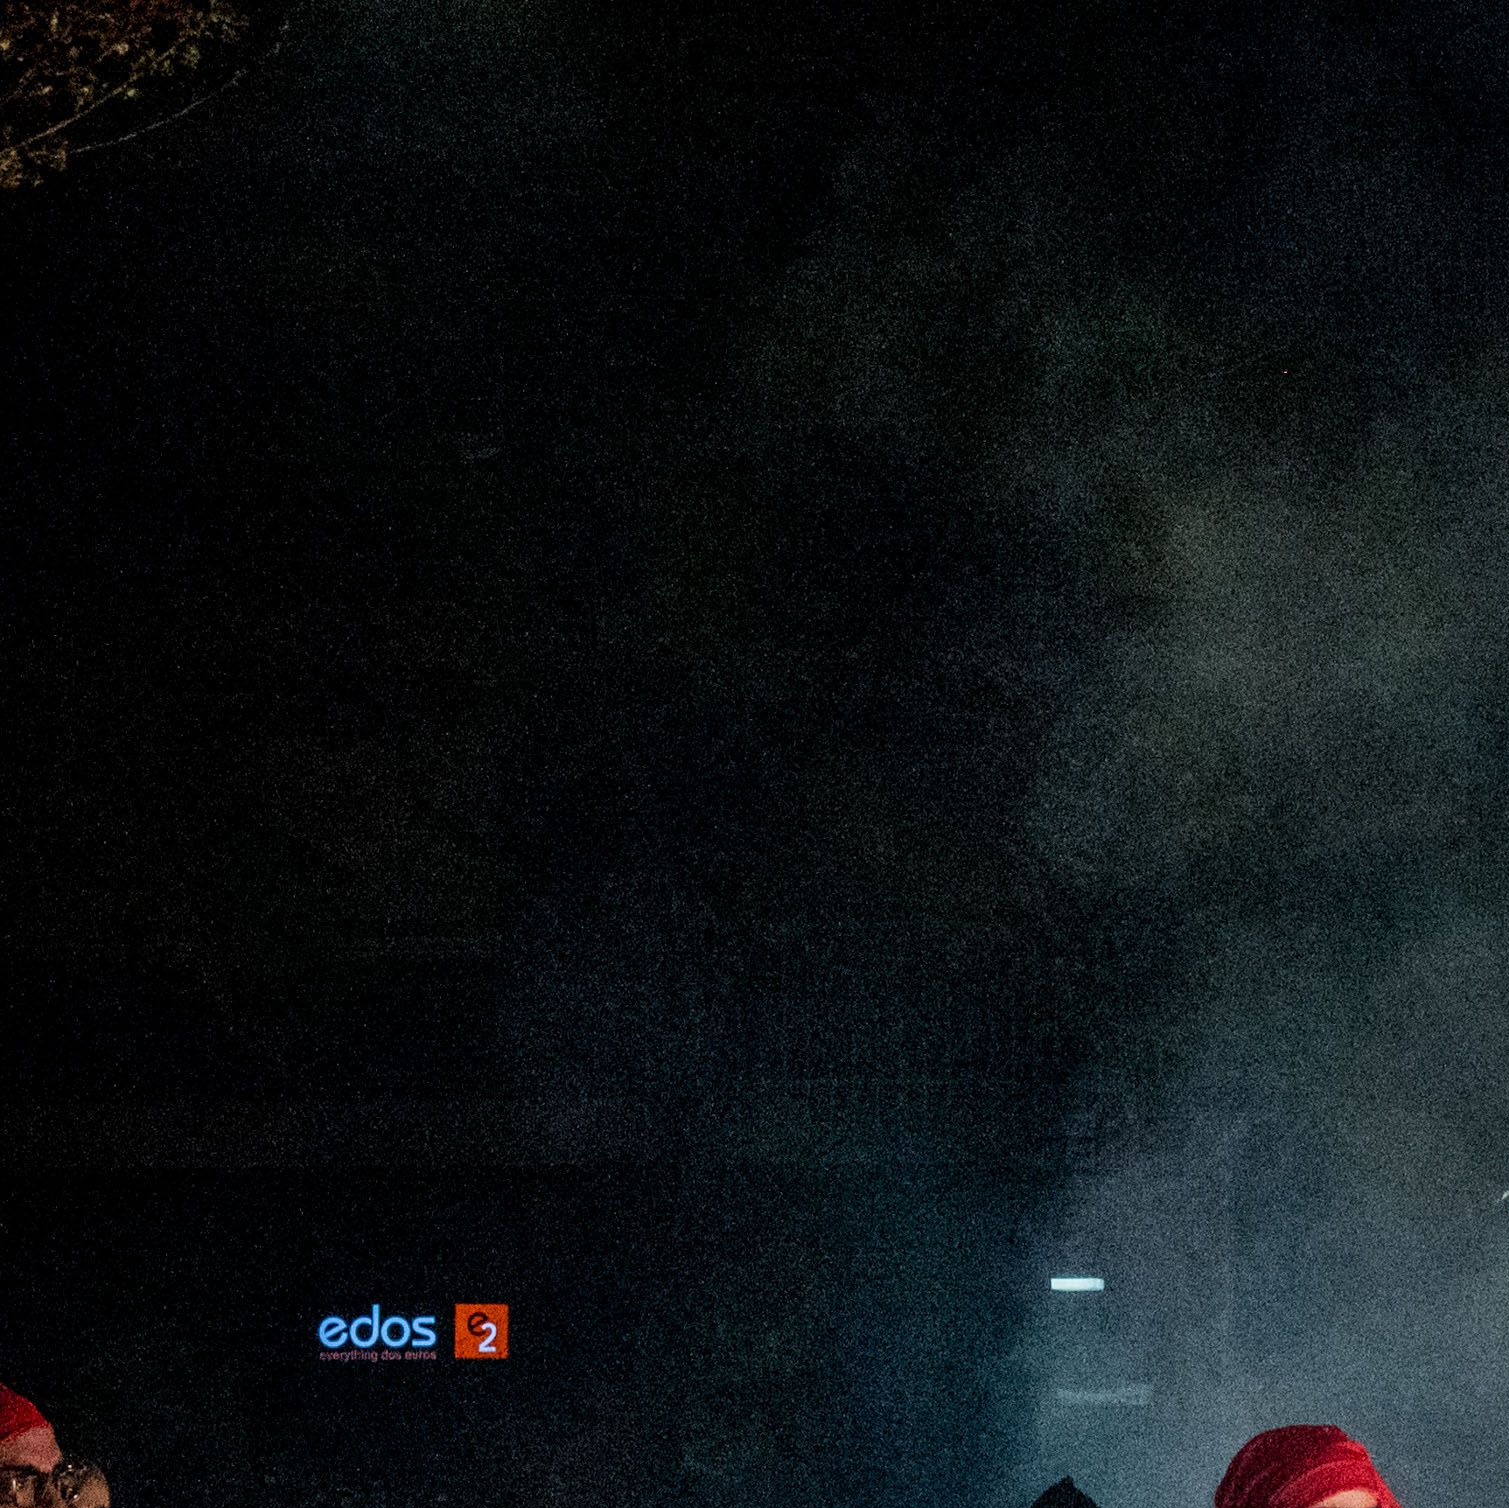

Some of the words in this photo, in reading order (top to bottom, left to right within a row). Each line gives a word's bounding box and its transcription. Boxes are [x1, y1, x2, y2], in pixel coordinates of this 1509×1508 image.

[318, 1304, 436, 1348] edos
[319, 1350, 378, 1363] everything
[381, 1349, 402, 1361] dos
[405, 1350, 437, 1361] euros
